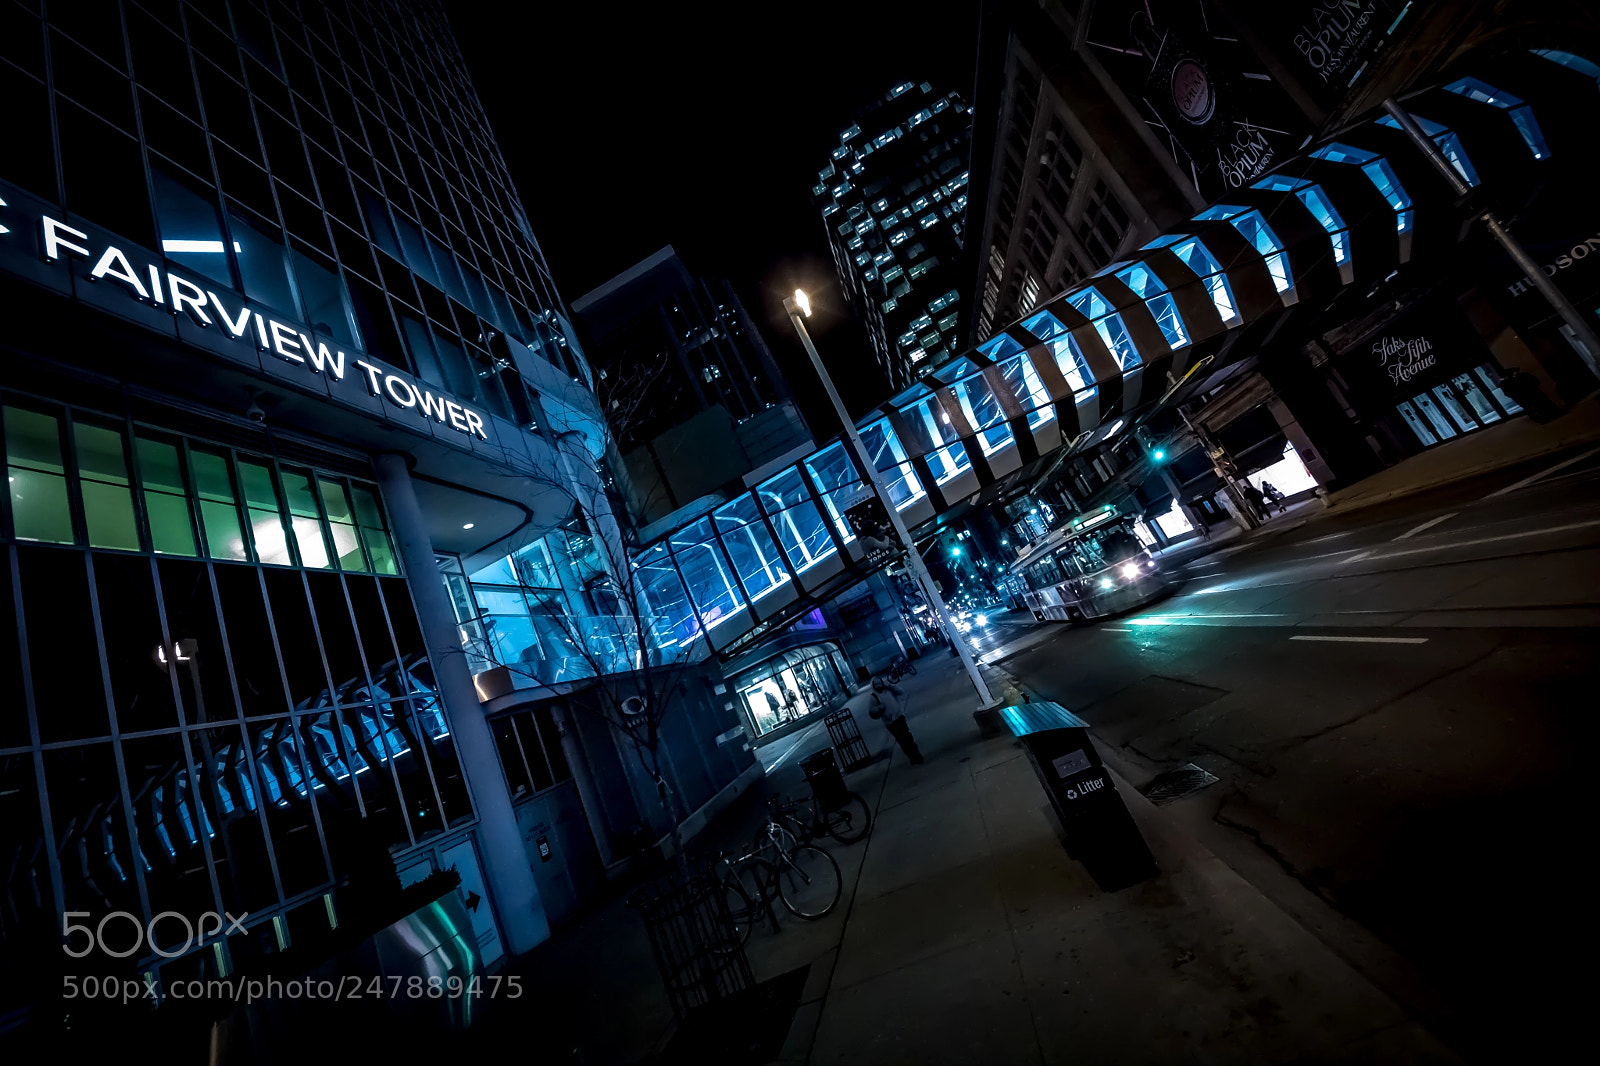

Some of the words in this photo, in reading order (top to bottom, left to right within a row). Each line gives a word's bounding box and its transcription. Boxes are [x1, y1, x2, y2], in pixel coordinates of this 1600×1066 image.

[1293, 0, 1340, 55] BLAC
[1309, 0, 1361, 68] OPIUM
[1218, 116, 1258, 177] BLACK
[1230, 132, 1269, 188] OPIUM
[42, 215, 346, 382] FAIRVIEW
[357, 359, 488, 440] TOWER
[1372, 336, 1406, 367] Saks
[1387, 354, 1437, 387] Avenue
[1076, 776, 1105, 796] Litter
